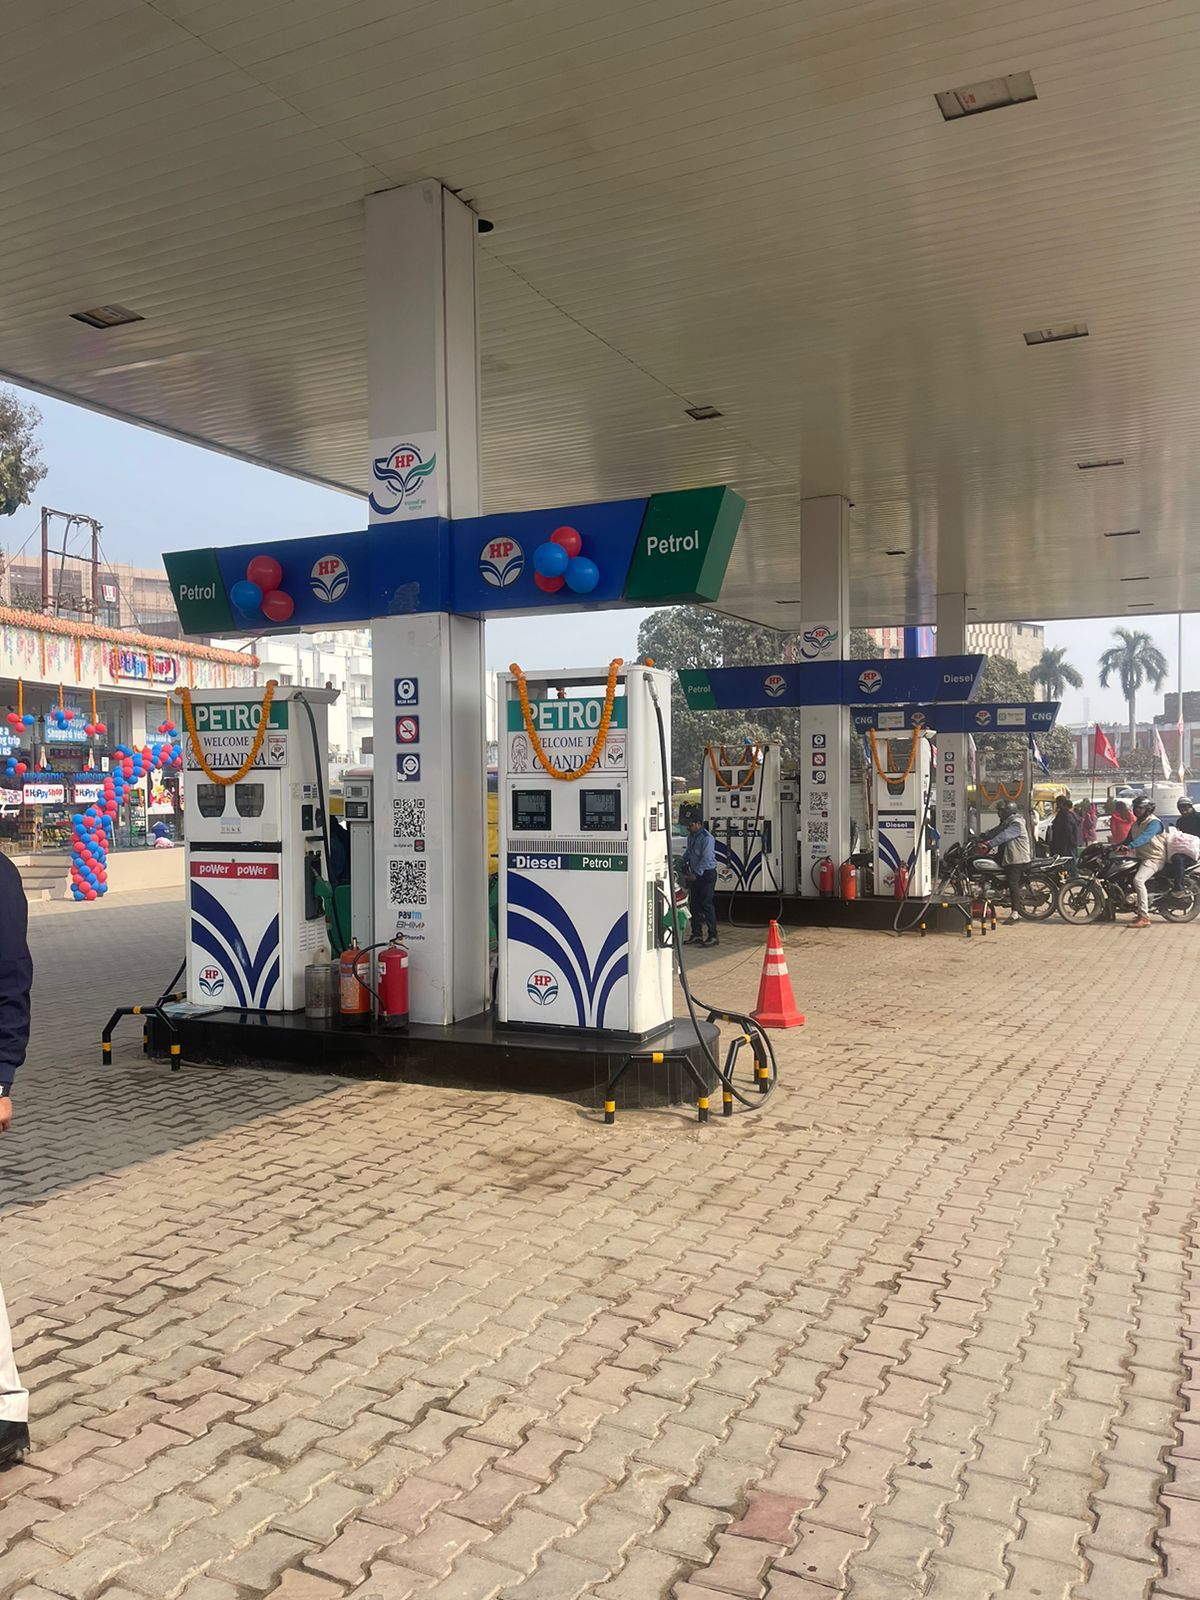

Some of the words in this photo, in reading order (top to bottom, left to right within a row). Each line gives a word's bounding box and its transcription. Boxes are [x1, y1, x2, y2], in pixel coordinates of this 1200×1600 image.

[395, 454, 414, 468] HP
[646, 530, 699, 556] Petrol
[489, 541, 513, 559] HP
[318, 559, 340, 576] HP
[179, 583, 216, 600] Petrol
[863, 672, 877, 680] HP
[943, 674, 973, 683] Diesel
[687, 685, 711, 693] Petrol
[855, 716, 873, 724] CNG
[1032, 712, 1053, 720] CNG
[203, 736, 250, 748] WELCOME
[540, 736, 584, 748] ELCOME
[515, 855, 562, 869] Diesel
[582, 857, 612, 869] Petrol
[204, 969, 219, 980] HP
[533, 975, 552, 987] HP
